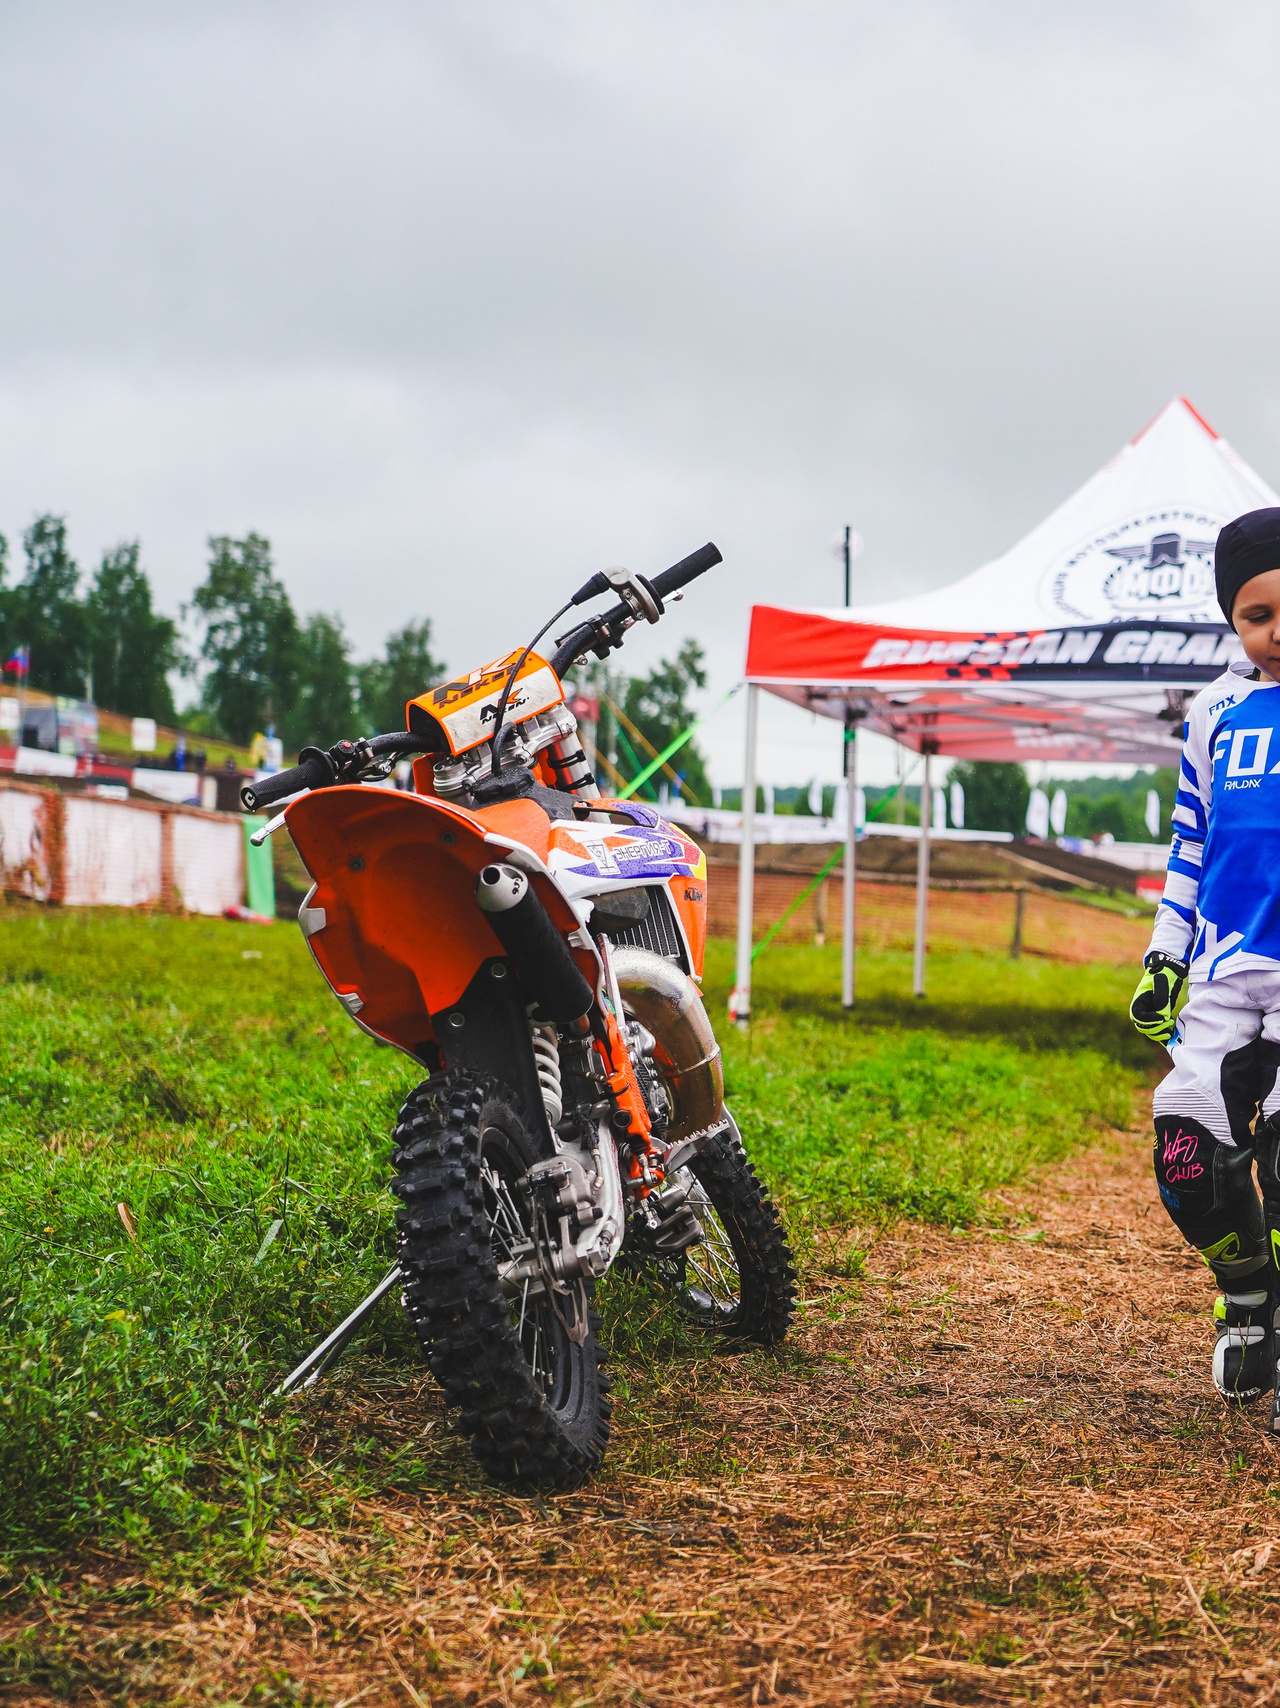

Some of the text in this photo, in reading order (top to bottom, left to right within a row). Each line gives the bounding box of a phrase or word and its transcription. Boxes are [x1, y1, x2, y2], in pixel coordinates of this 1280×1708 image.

[861, 631, 1104, 668] RUSSIAN
[1208, 695, 1237, 716] FOX
[1165, 955, 1187, 969] THOR
[1163, 1128, 1198, 1165] WFO
[1166, 1163, 1204, 1183] CLUB
